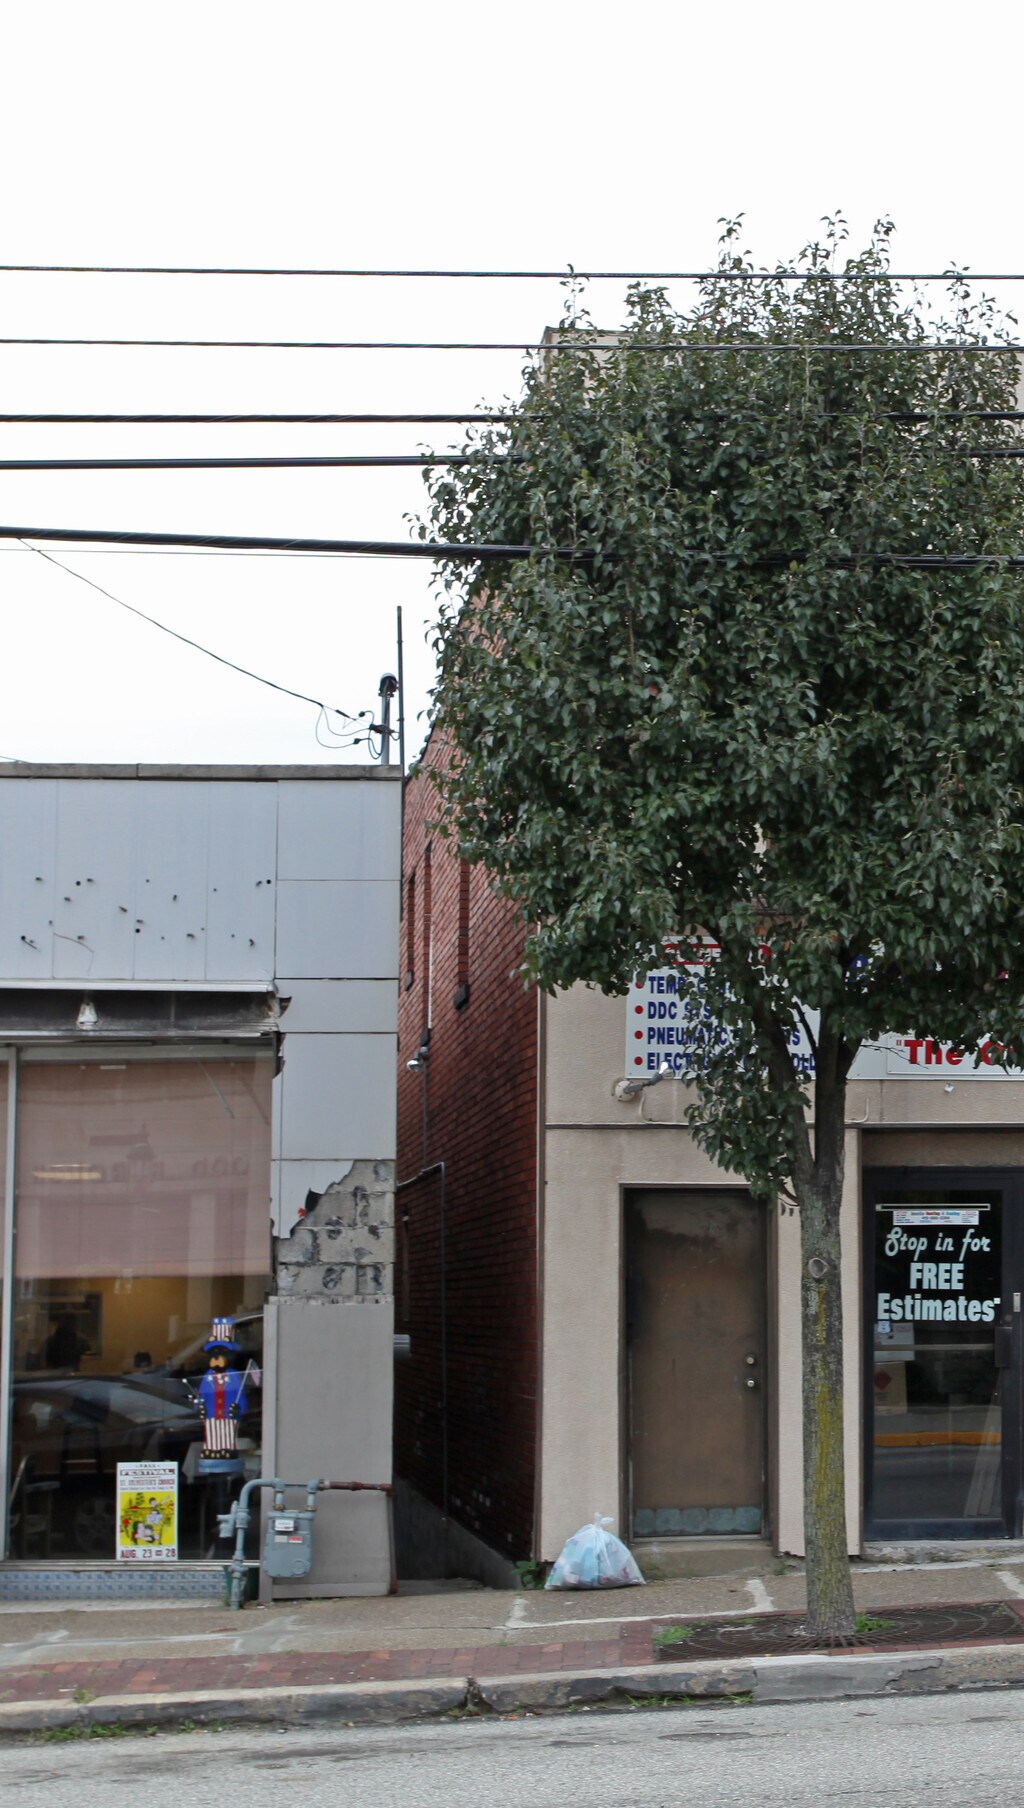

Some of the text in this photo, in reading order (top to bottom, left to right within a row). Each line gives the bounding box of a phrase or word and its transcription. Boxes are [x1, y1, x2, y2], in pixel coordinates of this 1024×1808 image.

[648, 1001, 678, 1020] DDC
[648, 1027, 728, 1045] PNEUMATC
[884, 1227, 991, 1262] Stop in for
[910, 1263, 965, 1290] FREE
[877, 1293, 995, 1322] Estimates
[142, 1548, 153, 1558] 23
[165, 1548, 176, 1558] 28
